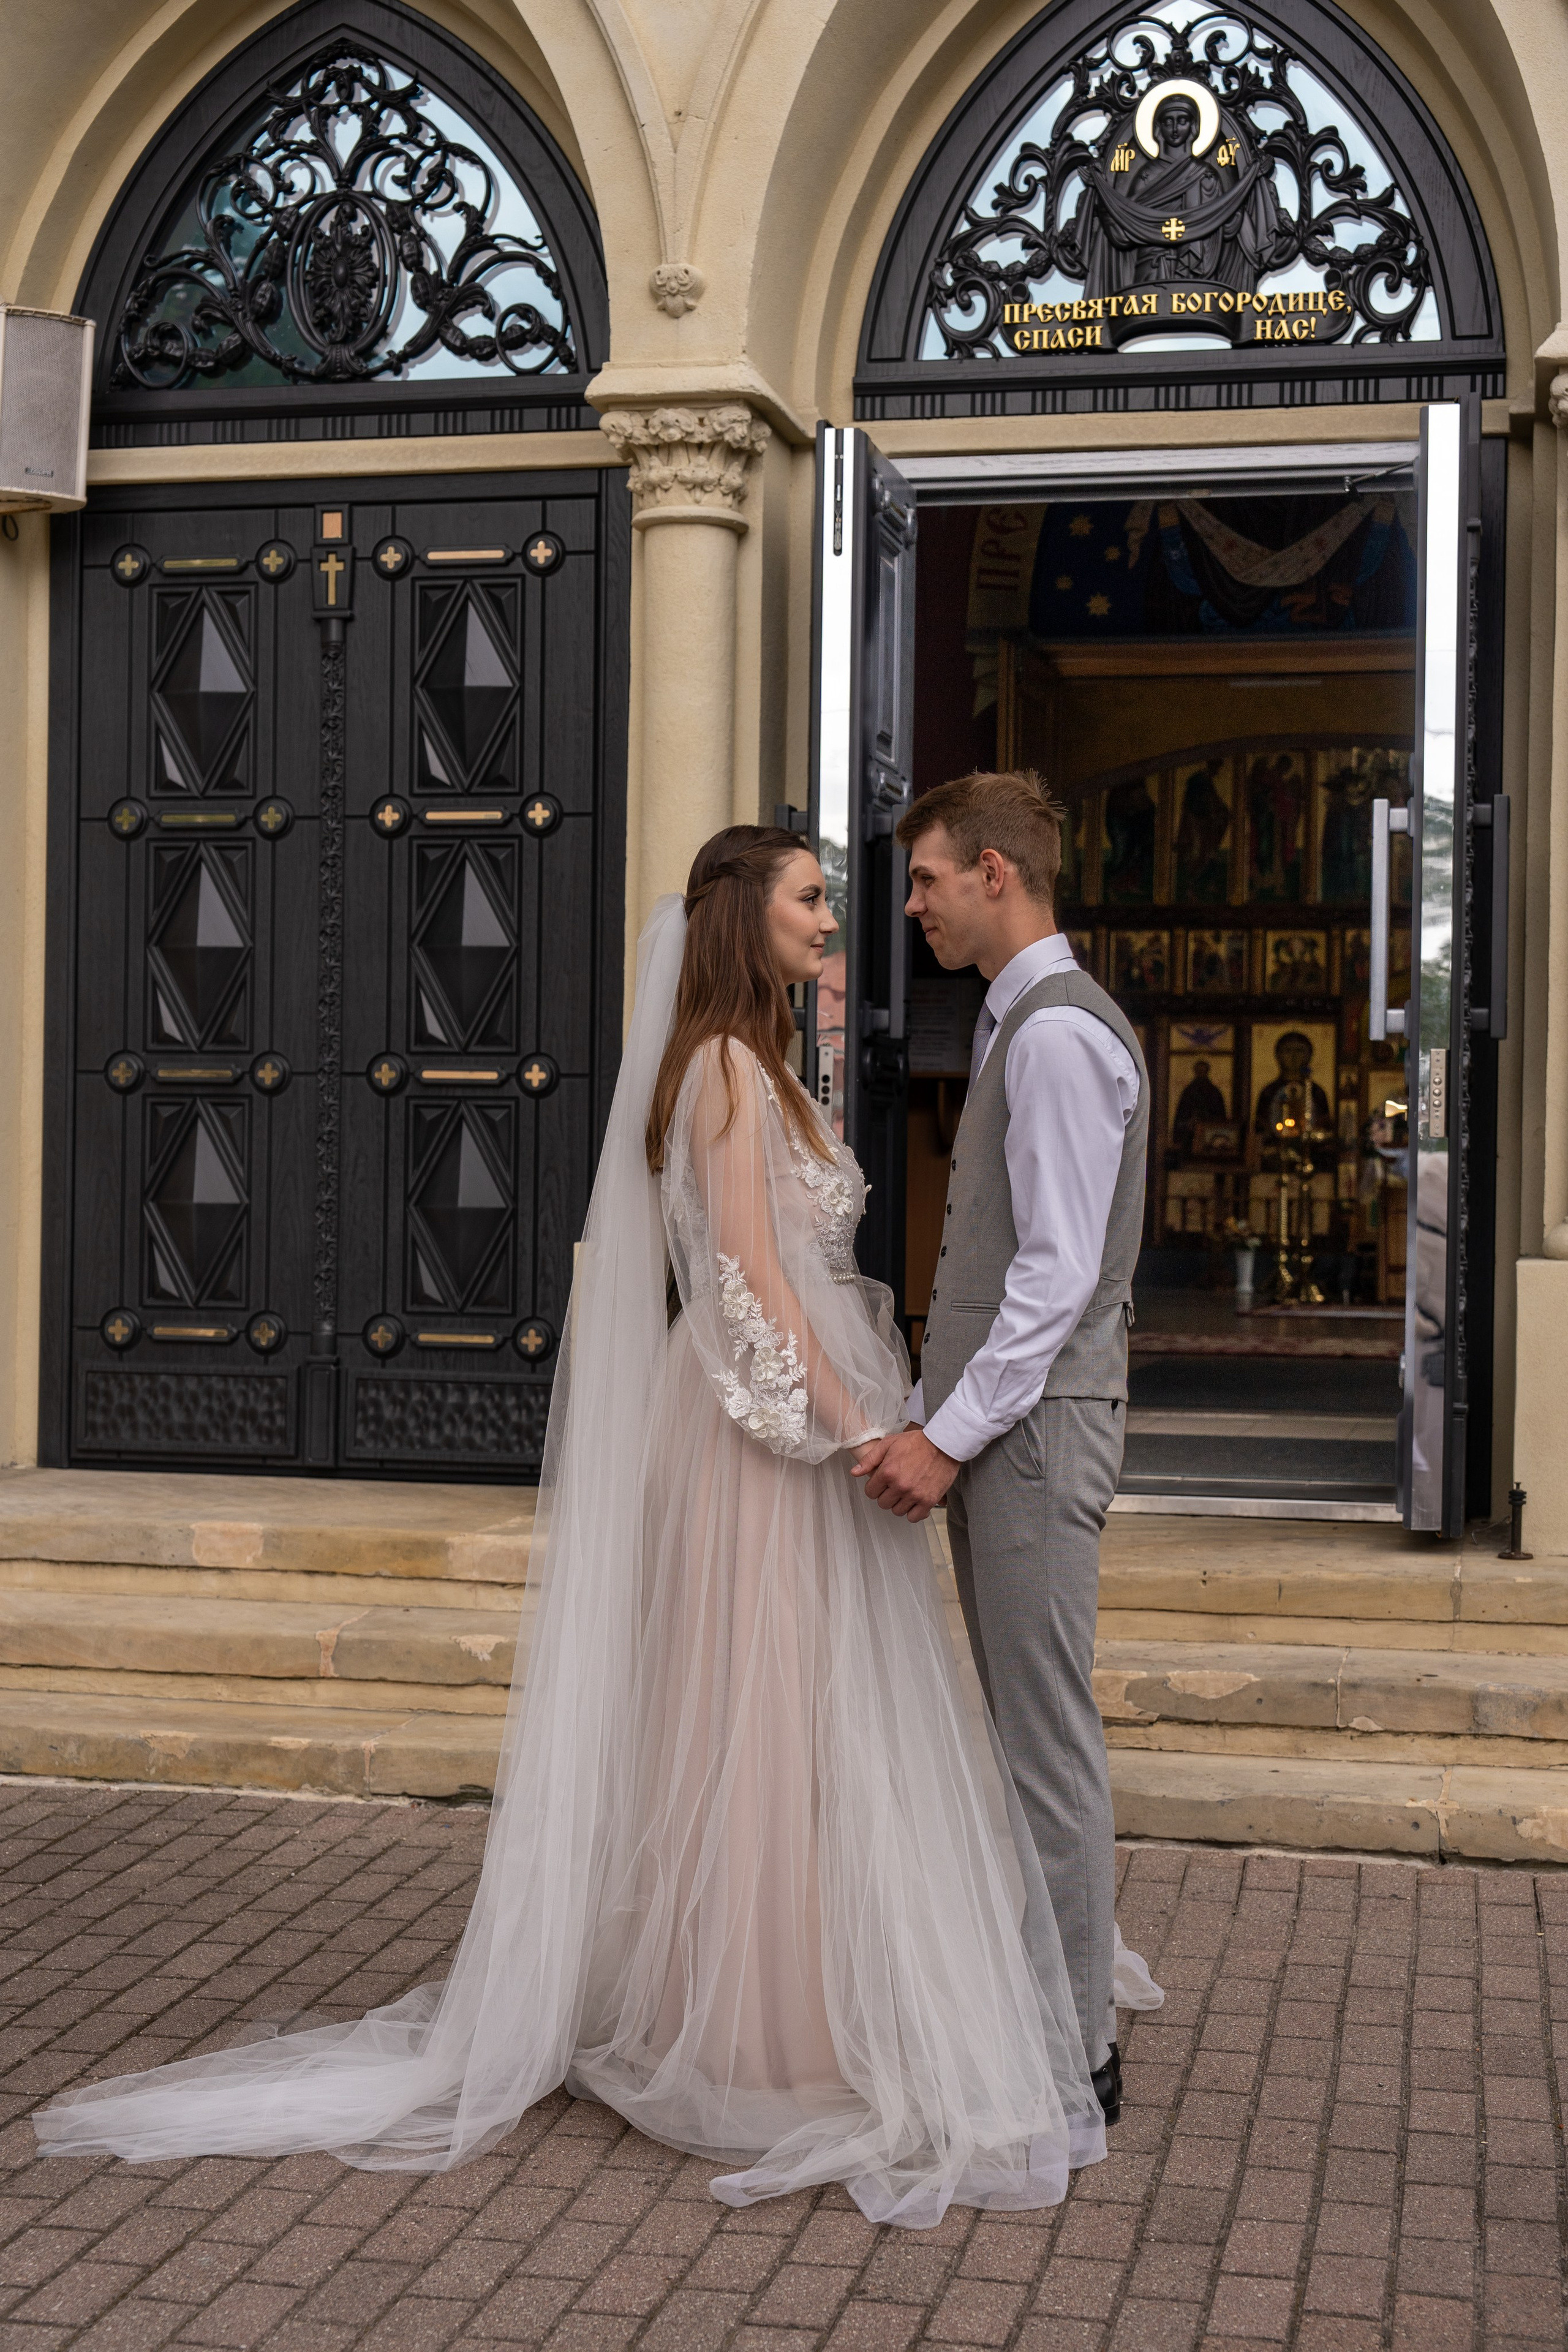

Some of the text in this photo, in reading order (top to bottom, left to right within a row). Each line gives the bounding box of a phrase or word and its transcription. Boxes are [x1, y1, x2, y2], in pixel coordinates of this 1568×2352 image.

[1003, 290, 1352, 324] ПРЕСВЯТАЯ БОГОРОДИЦЕ,
[1014, 316, 1316, 350] СПАСИ НАС!
